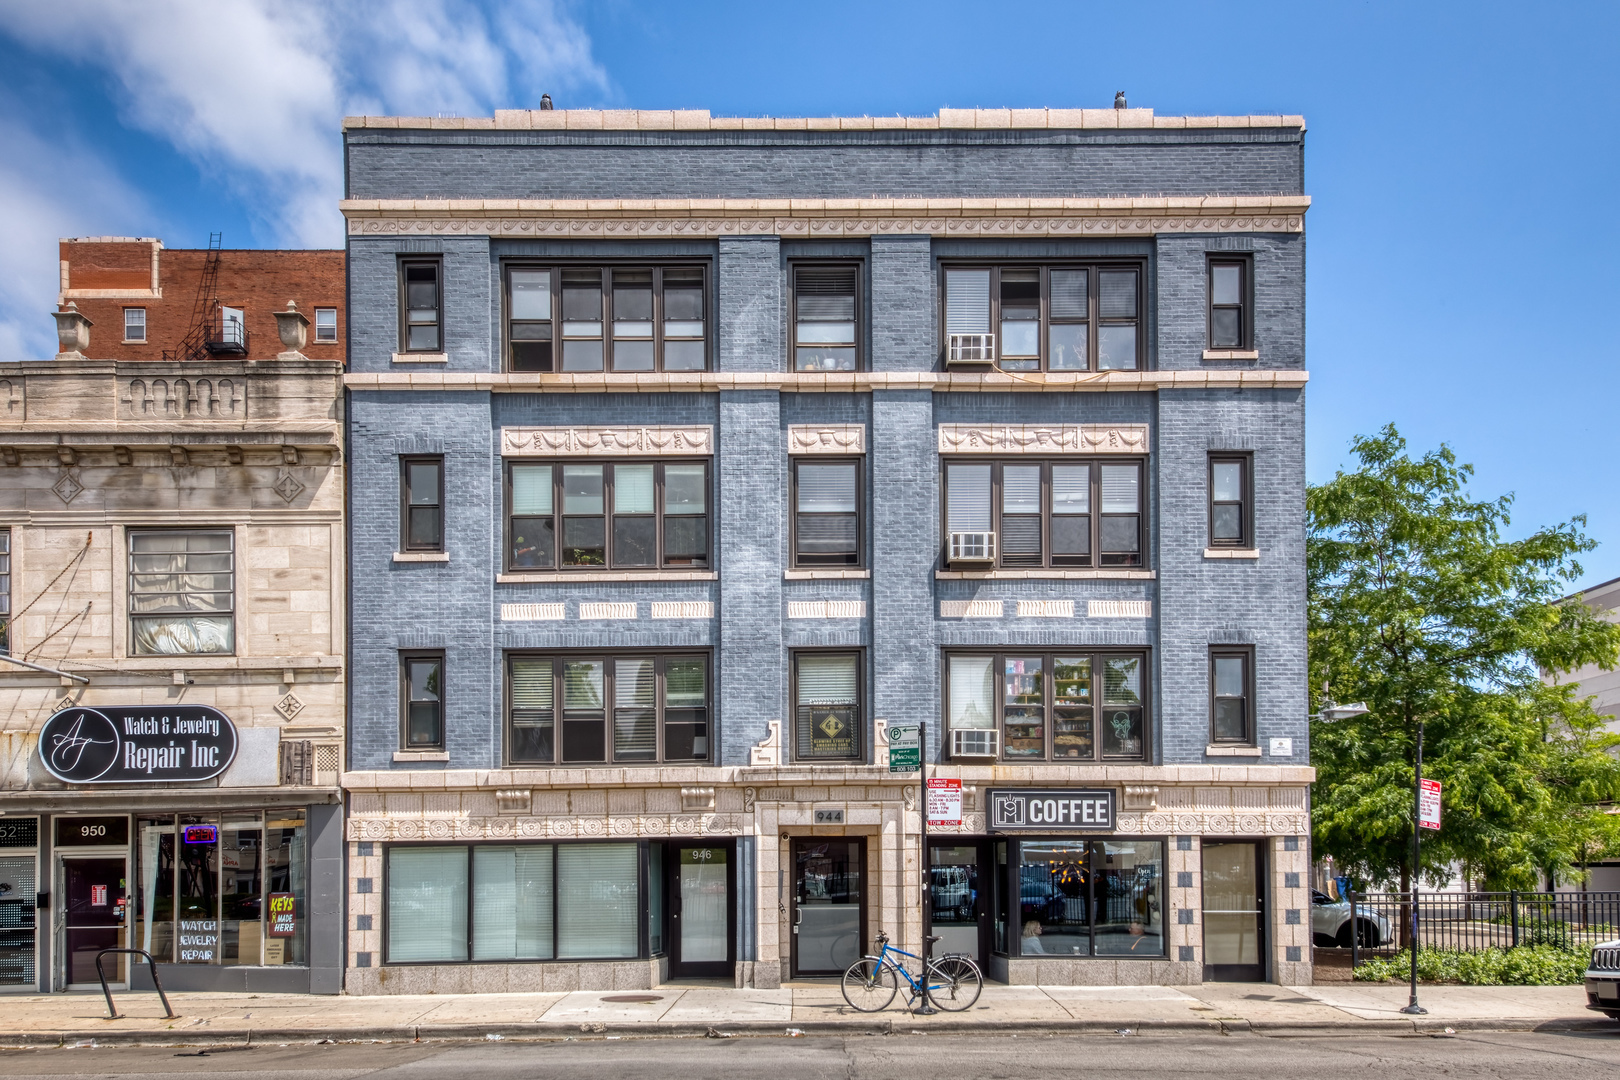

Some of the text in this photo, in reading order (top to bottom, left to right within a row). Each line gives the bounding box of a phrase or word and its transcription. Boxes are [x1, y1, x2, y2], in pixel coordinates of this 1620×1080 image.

[124, 716, 220, 736] Watch & Jewelry
[124, 740, 219, 773] Repair Inc
[1030, 800, 1108, 822] COFFEE
[817, 812, 841, 822] 944
[81, 826, 106, 836] 950
[187, 828, 214, 840] OPEN
[692, 850, 712, 859] 946
[1138, 868, 1151, 876] Open
[270, 897, 294, 911] KEYS
[277, 914, 293, 923] MADE
[182, 921, 216, 931] WATCH
[274, 923, 294, 932] HERE
[179, 935, 218, 946] JEWELRY
[182, 950, 212, 960] REPAIR
